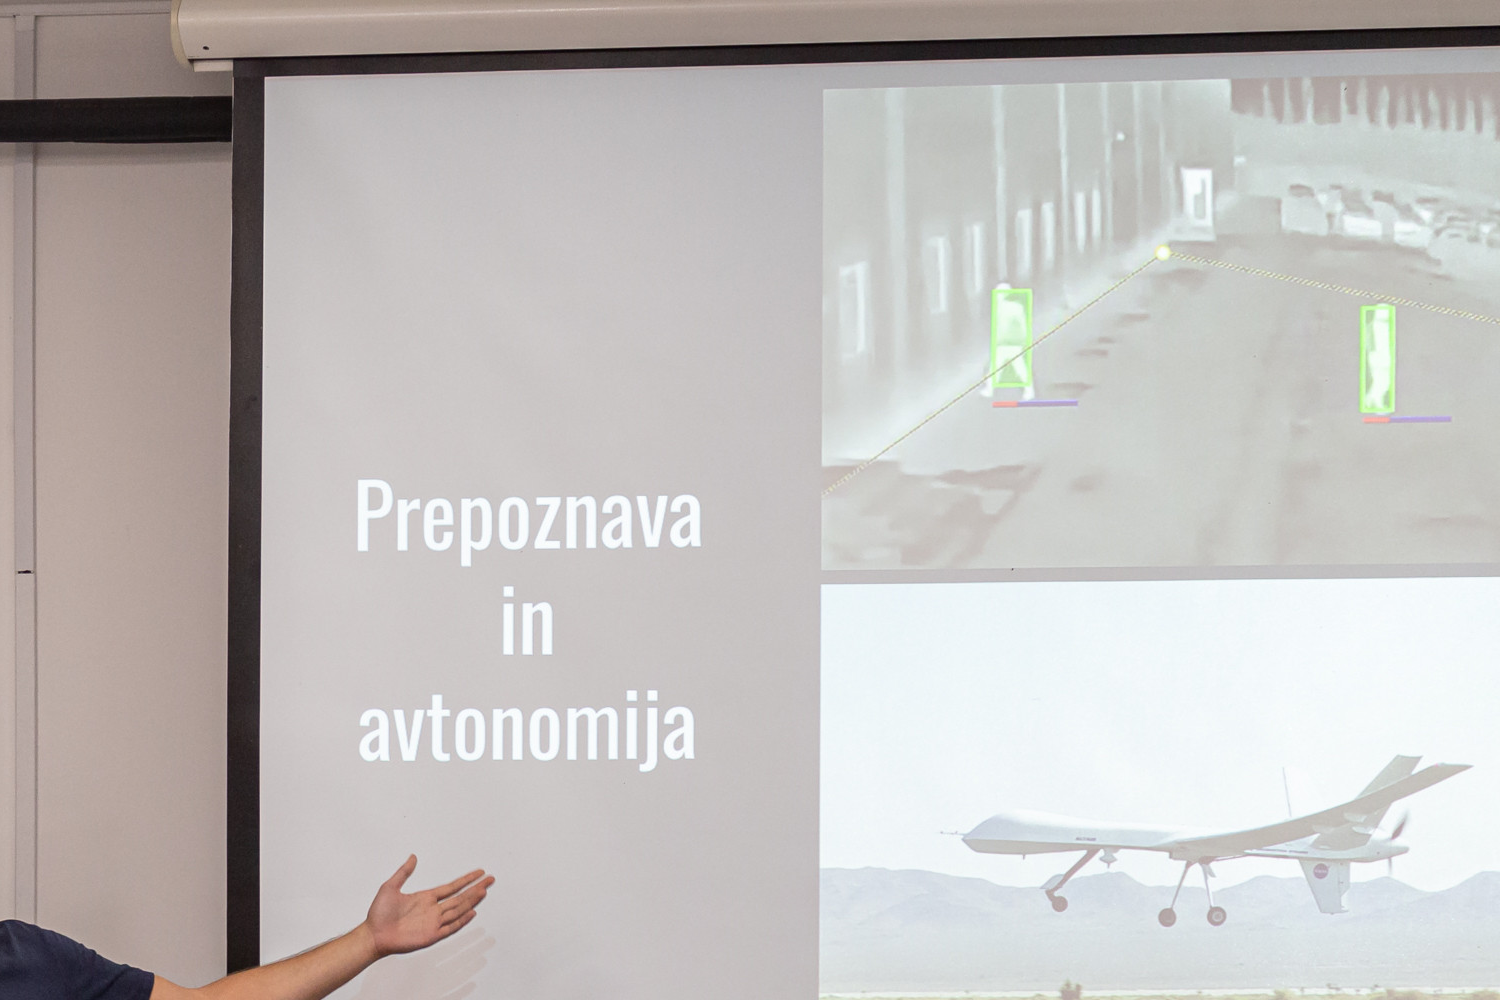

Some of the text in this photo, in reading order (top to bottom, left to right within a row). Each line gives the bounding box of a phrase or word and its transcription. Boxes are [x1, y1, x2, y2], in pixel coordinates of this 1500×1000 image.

[357, 478, 701, 567] Prepoznava
[503, 586, 553, 655] in
[359, 689, 695, 772] avtonomija
